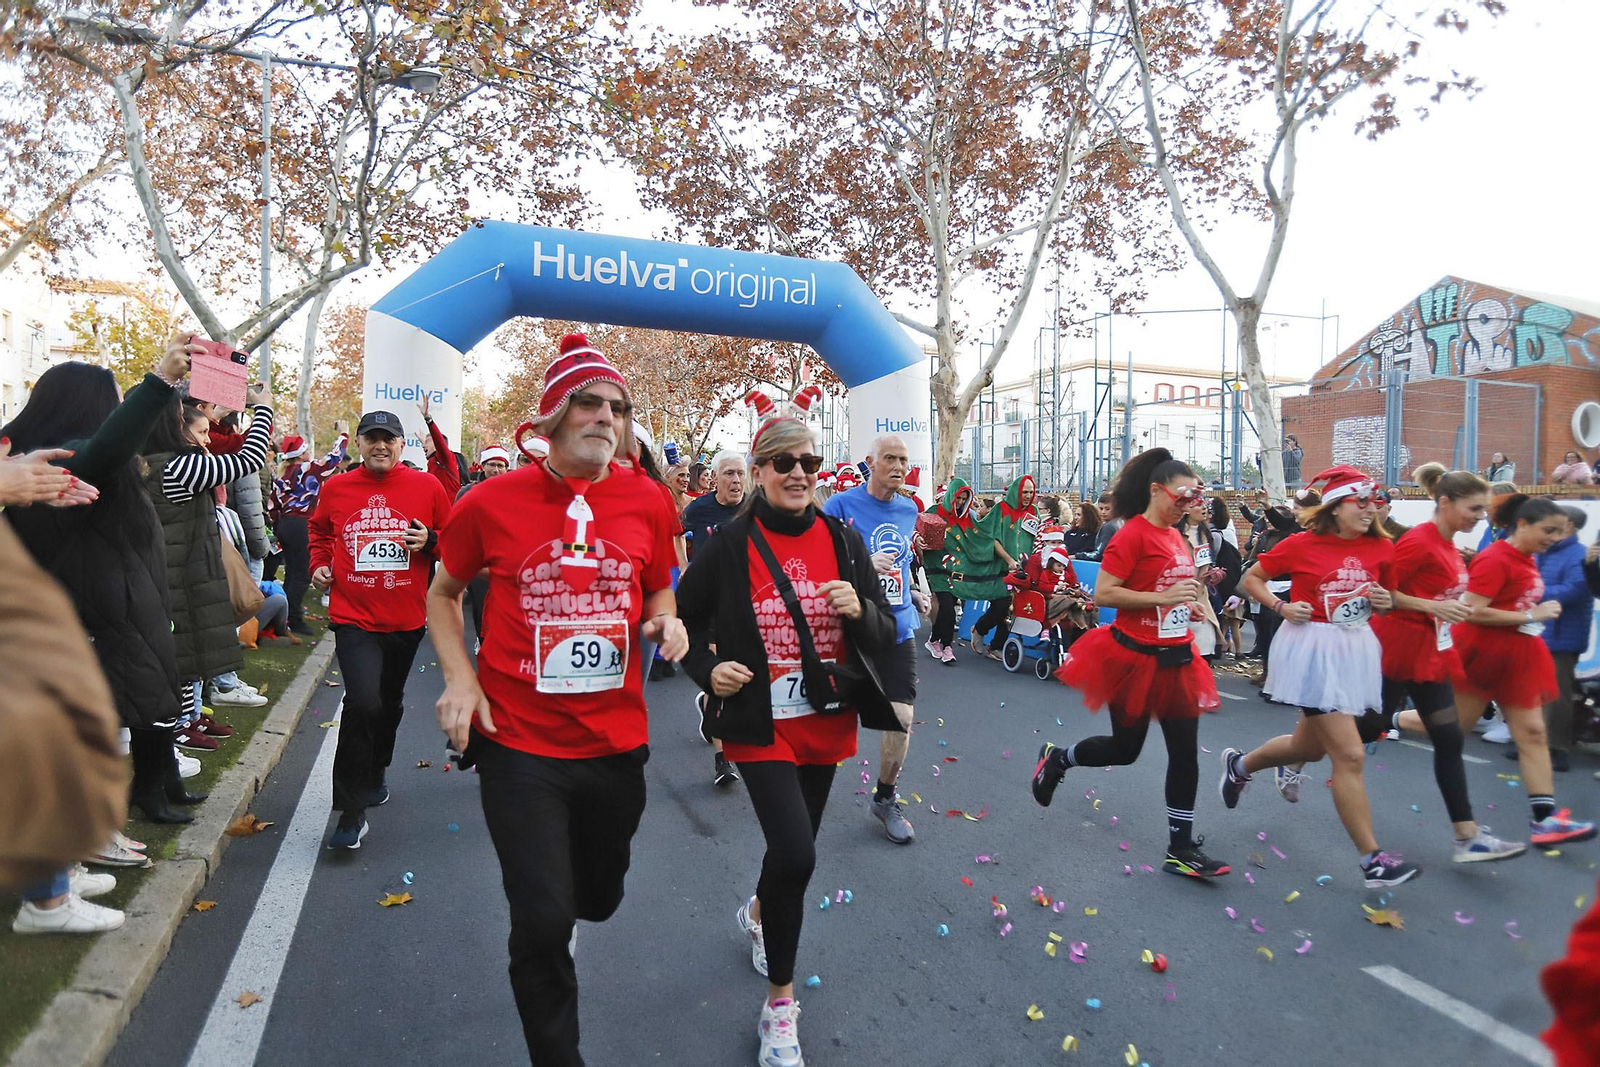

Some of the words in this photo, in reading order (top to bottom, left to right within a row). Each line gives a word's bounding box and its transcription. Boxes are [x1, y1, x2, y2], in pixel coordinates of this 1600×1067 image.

[533, 241, 676, 291] Huelva
[690, 263, 816, 308] original
[375, 383, 443, 403] Huelva
[876, 417, 928, 432] Huelva
[360, 507, 391, 518] XIII
[345, 518, 409, 532] CARRERA
[368, 543, 396, 558] 453
[347, 573, 375, 584] Huelva
[522, 595, 544, 611] DE
[544, 591, 631, 614] HUELVA
[571, 641, 602, 668] 59
